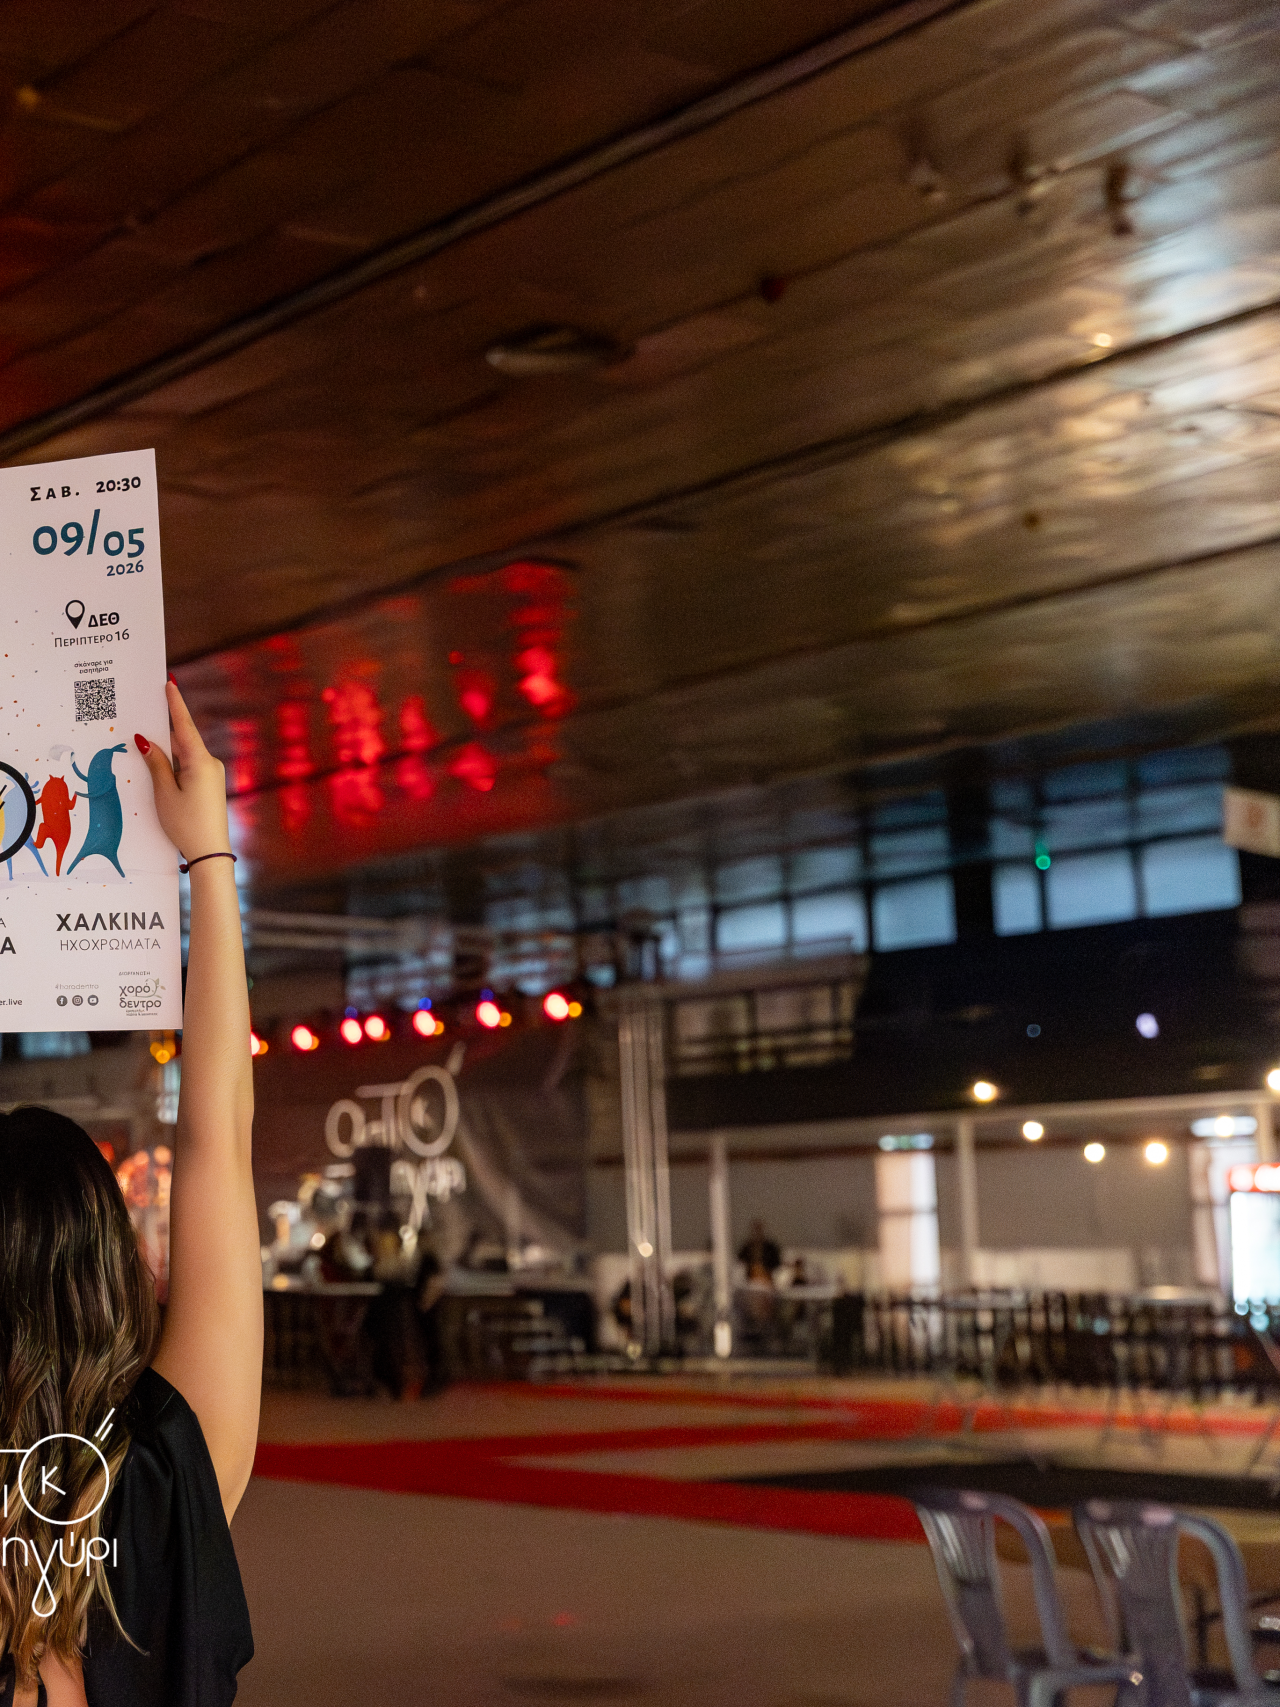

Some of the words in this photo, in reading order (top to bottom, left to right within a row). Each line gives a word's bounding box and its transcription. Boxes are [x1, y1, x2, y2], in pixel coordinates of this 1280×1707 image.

[30, 486, 80, 501] ΣΑΒ.
[96, 476, 141, 493] 20:30
[32, 508, 145, 559] 09/05
[106, 560, 144, 577] 2026
[88, 612, 120, 628] ΔΕΘ
[54, 633, 114, 647] ΠΕΡΙΠΤΕΡΟ
[114, 628, 130, 641] 16
[55, 911, 165, 932] ΧΑΛΚΙΝΑ
[60, 938, 161, 951] ΗΧΟΧΡΩΜΑΤΑ
[119, 982, 151, 997] χορό
[119, 997, 162, 1011] δεντρο
